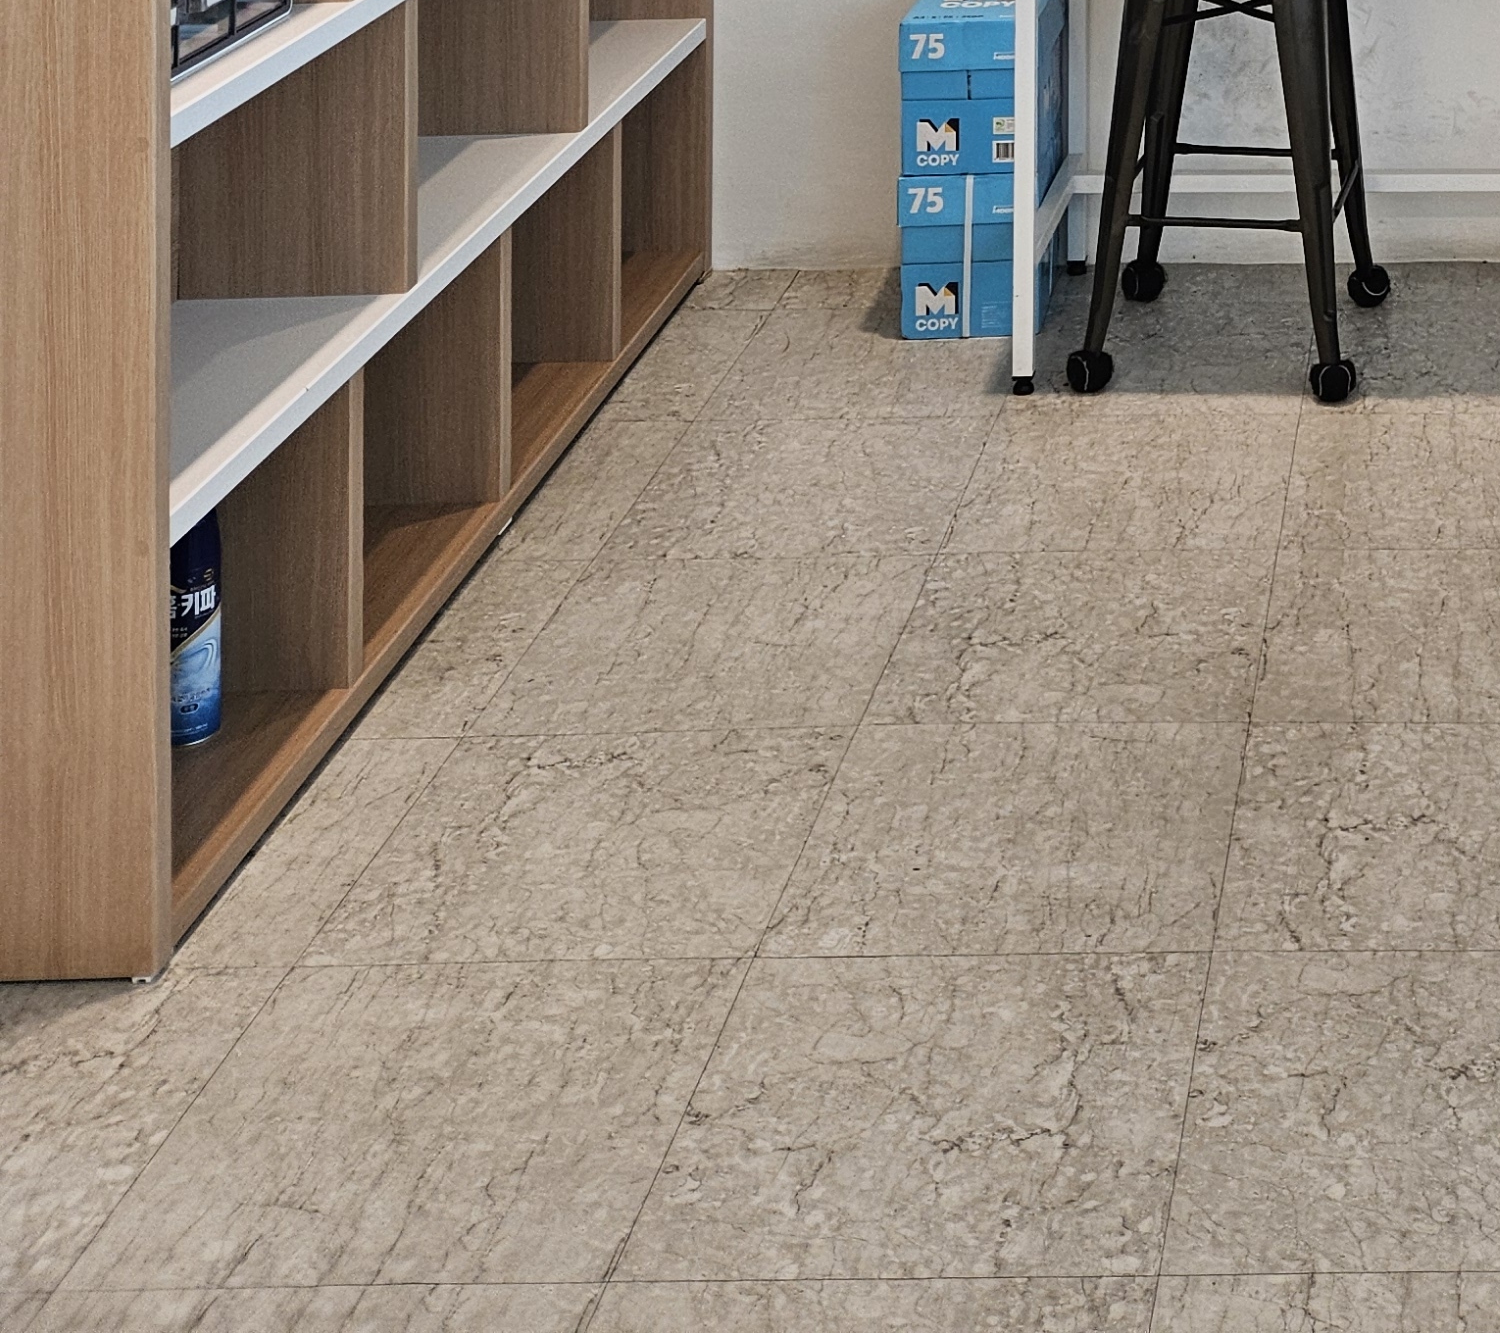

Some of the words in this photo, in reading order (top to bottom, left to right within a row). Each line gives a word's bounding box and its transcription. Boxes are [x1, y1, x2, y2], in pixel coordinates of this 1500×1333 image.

[909, 33, 945, 60] 75
[916, 154, 960, 167] COPY
[907, 187, 944, 214] 75
[915, 317, 959, 331] COPY
